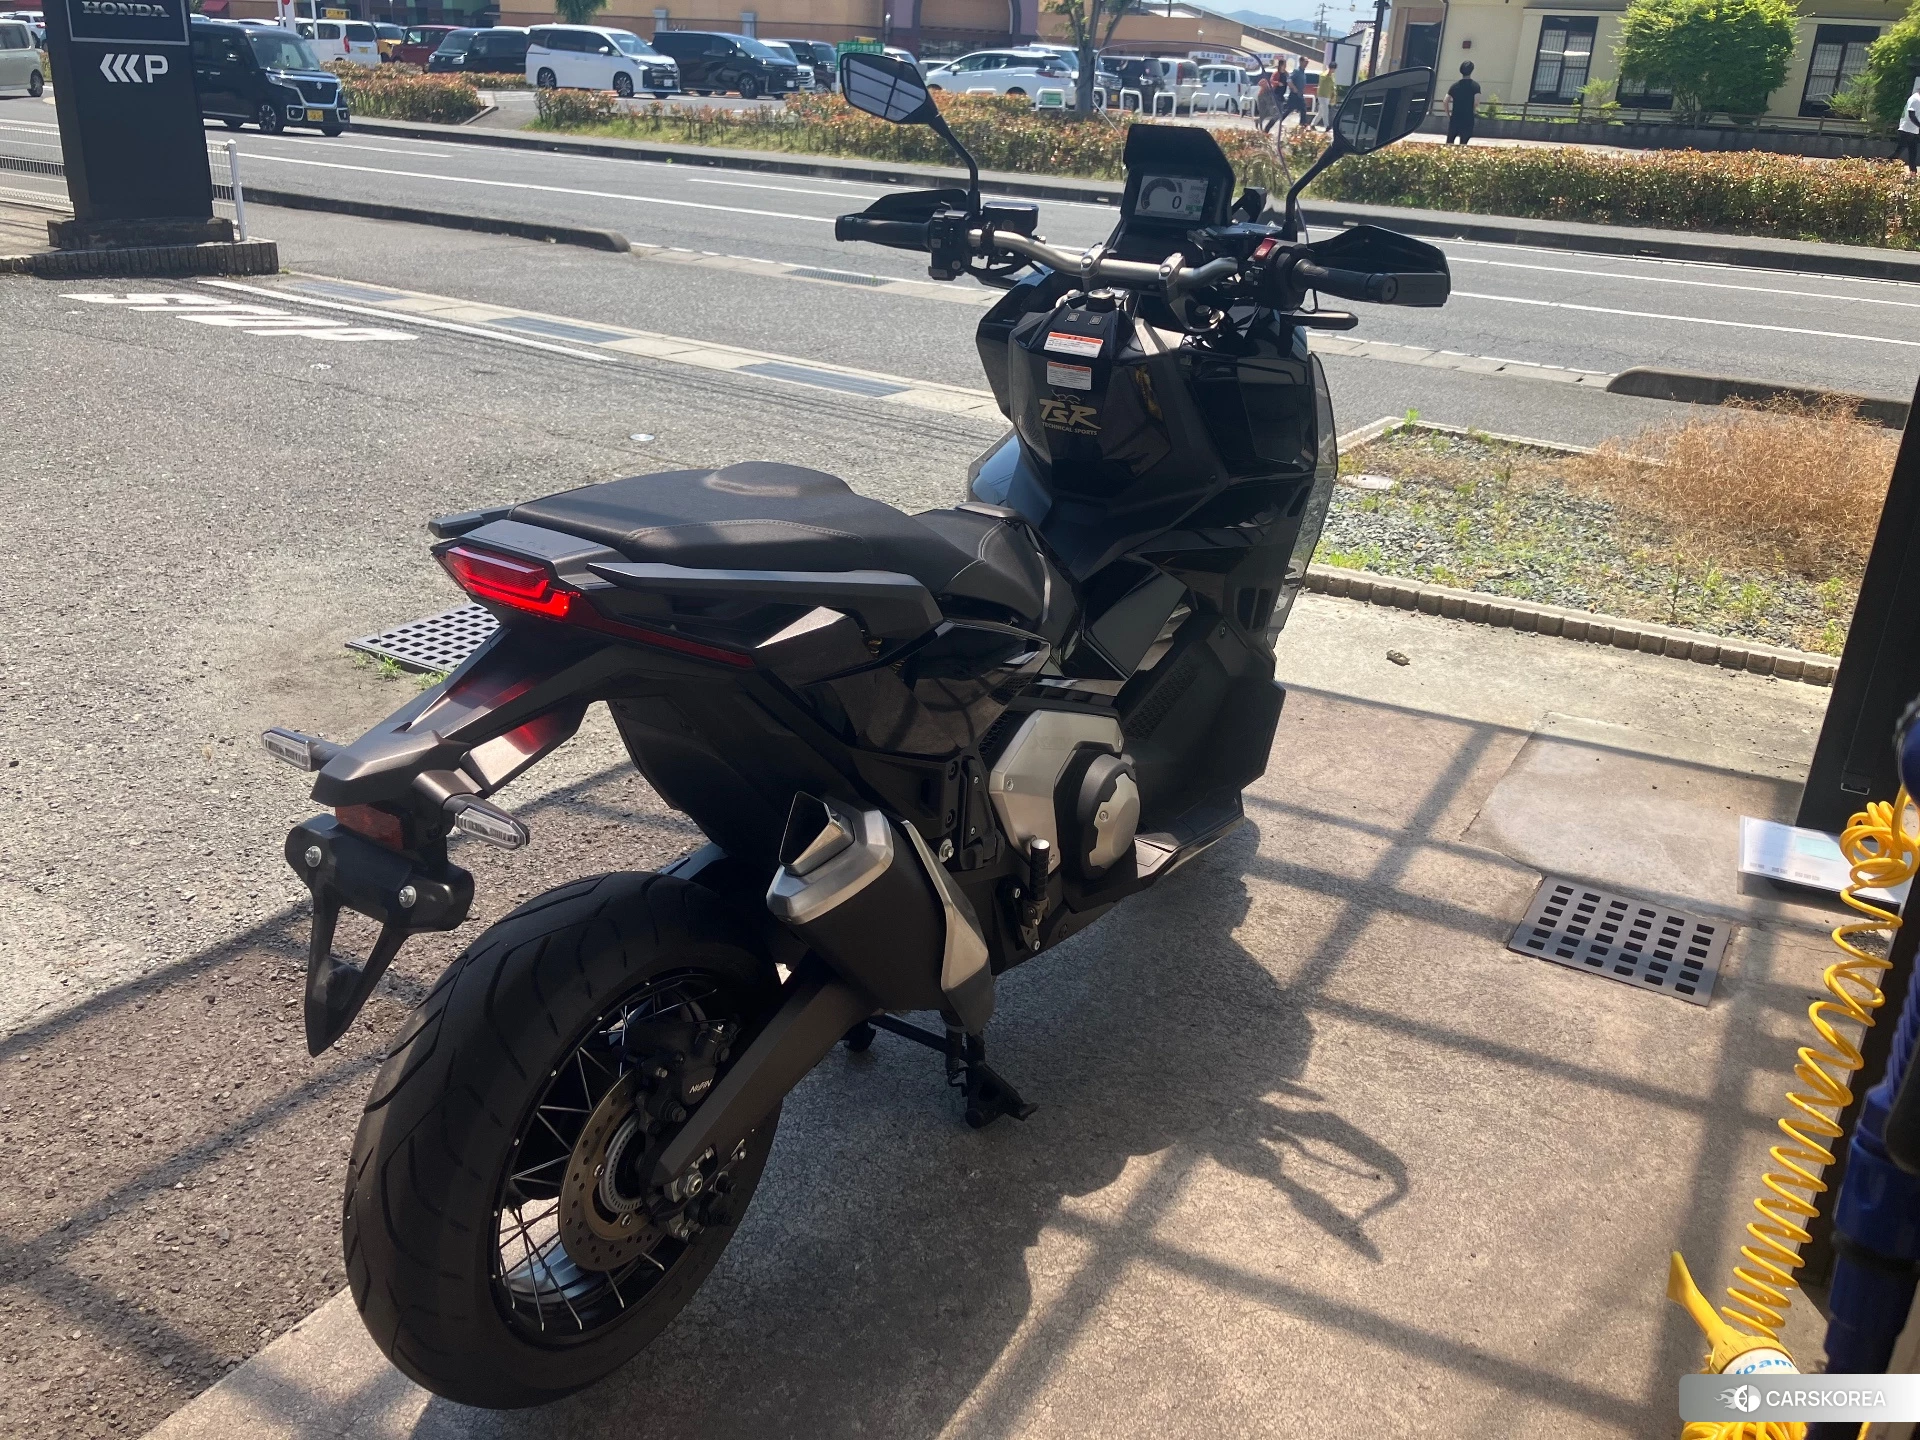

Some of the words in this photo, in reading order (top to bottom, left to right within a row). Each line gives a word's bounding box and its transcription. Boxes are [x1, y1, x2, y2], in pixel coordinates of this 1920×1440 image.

[82, 1, 170, 17] HONDA
[144, 54, 169, 83] P
[1171, 196, 1182, 209] 0
[57, 293, 420, 341] STOP
[1039, 398, 1102, 430] TSR
[1041, 421, 1073, 433] TECHNICAL
[1074, 427, 1098, 436] SPORTS
